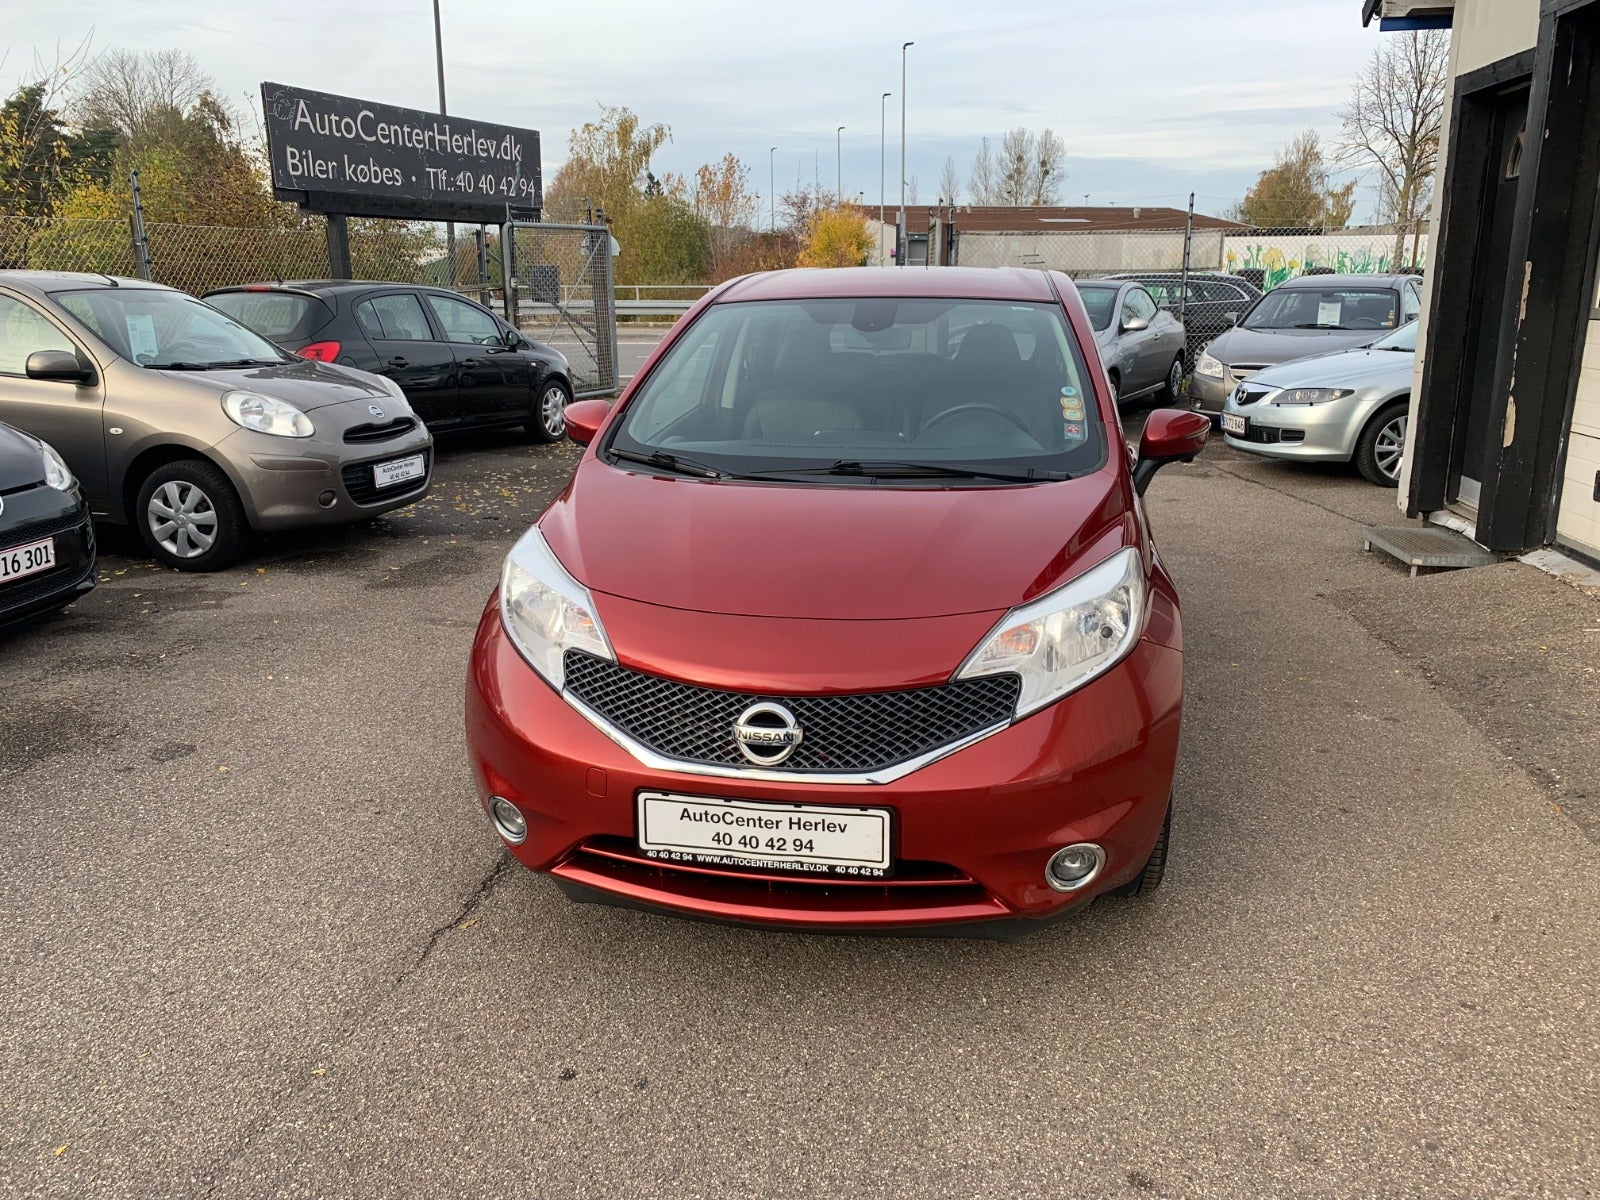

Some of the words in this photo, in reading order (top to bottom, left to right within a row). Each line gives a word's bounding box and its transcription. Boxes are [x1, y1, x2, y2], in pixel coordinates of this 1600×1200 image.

[294, 99, 522, 161] AutoCenterHerlev.dk
[286, 145, 337, 179] Biler
[344, 154, 402, 186] købes
[479, 174, 495, 195] 40
[500, 176, 516, 197] 42
[520, 178, 535, 198] 94
[1, 553, 21, 576] 16
[24, 545, 51, 570] 301
[738, 729, 794, 742] NISSAN
[679, 807, 783, 830] AutoCenter
[788, 817, 848, 833] Herlev
[711, 832, 733, 846] 40
[738, 835, 760, 849] 40
[765, 837, 787, 851] 42
[793, 838, 815, 852] 94
[646, 850, 658, 858] 40
[658, 851, 669, 859] 40
[670, 852, 681, 860] 42
[682, 853, 693, 861] 94
[696, 854, 829, 872] WWW.AUTOCENTERHERLEV.DK
[847, 866, 859, 875] 40
[860, 867, 871, 876] 42
[872, 868, 884, 877] 94
